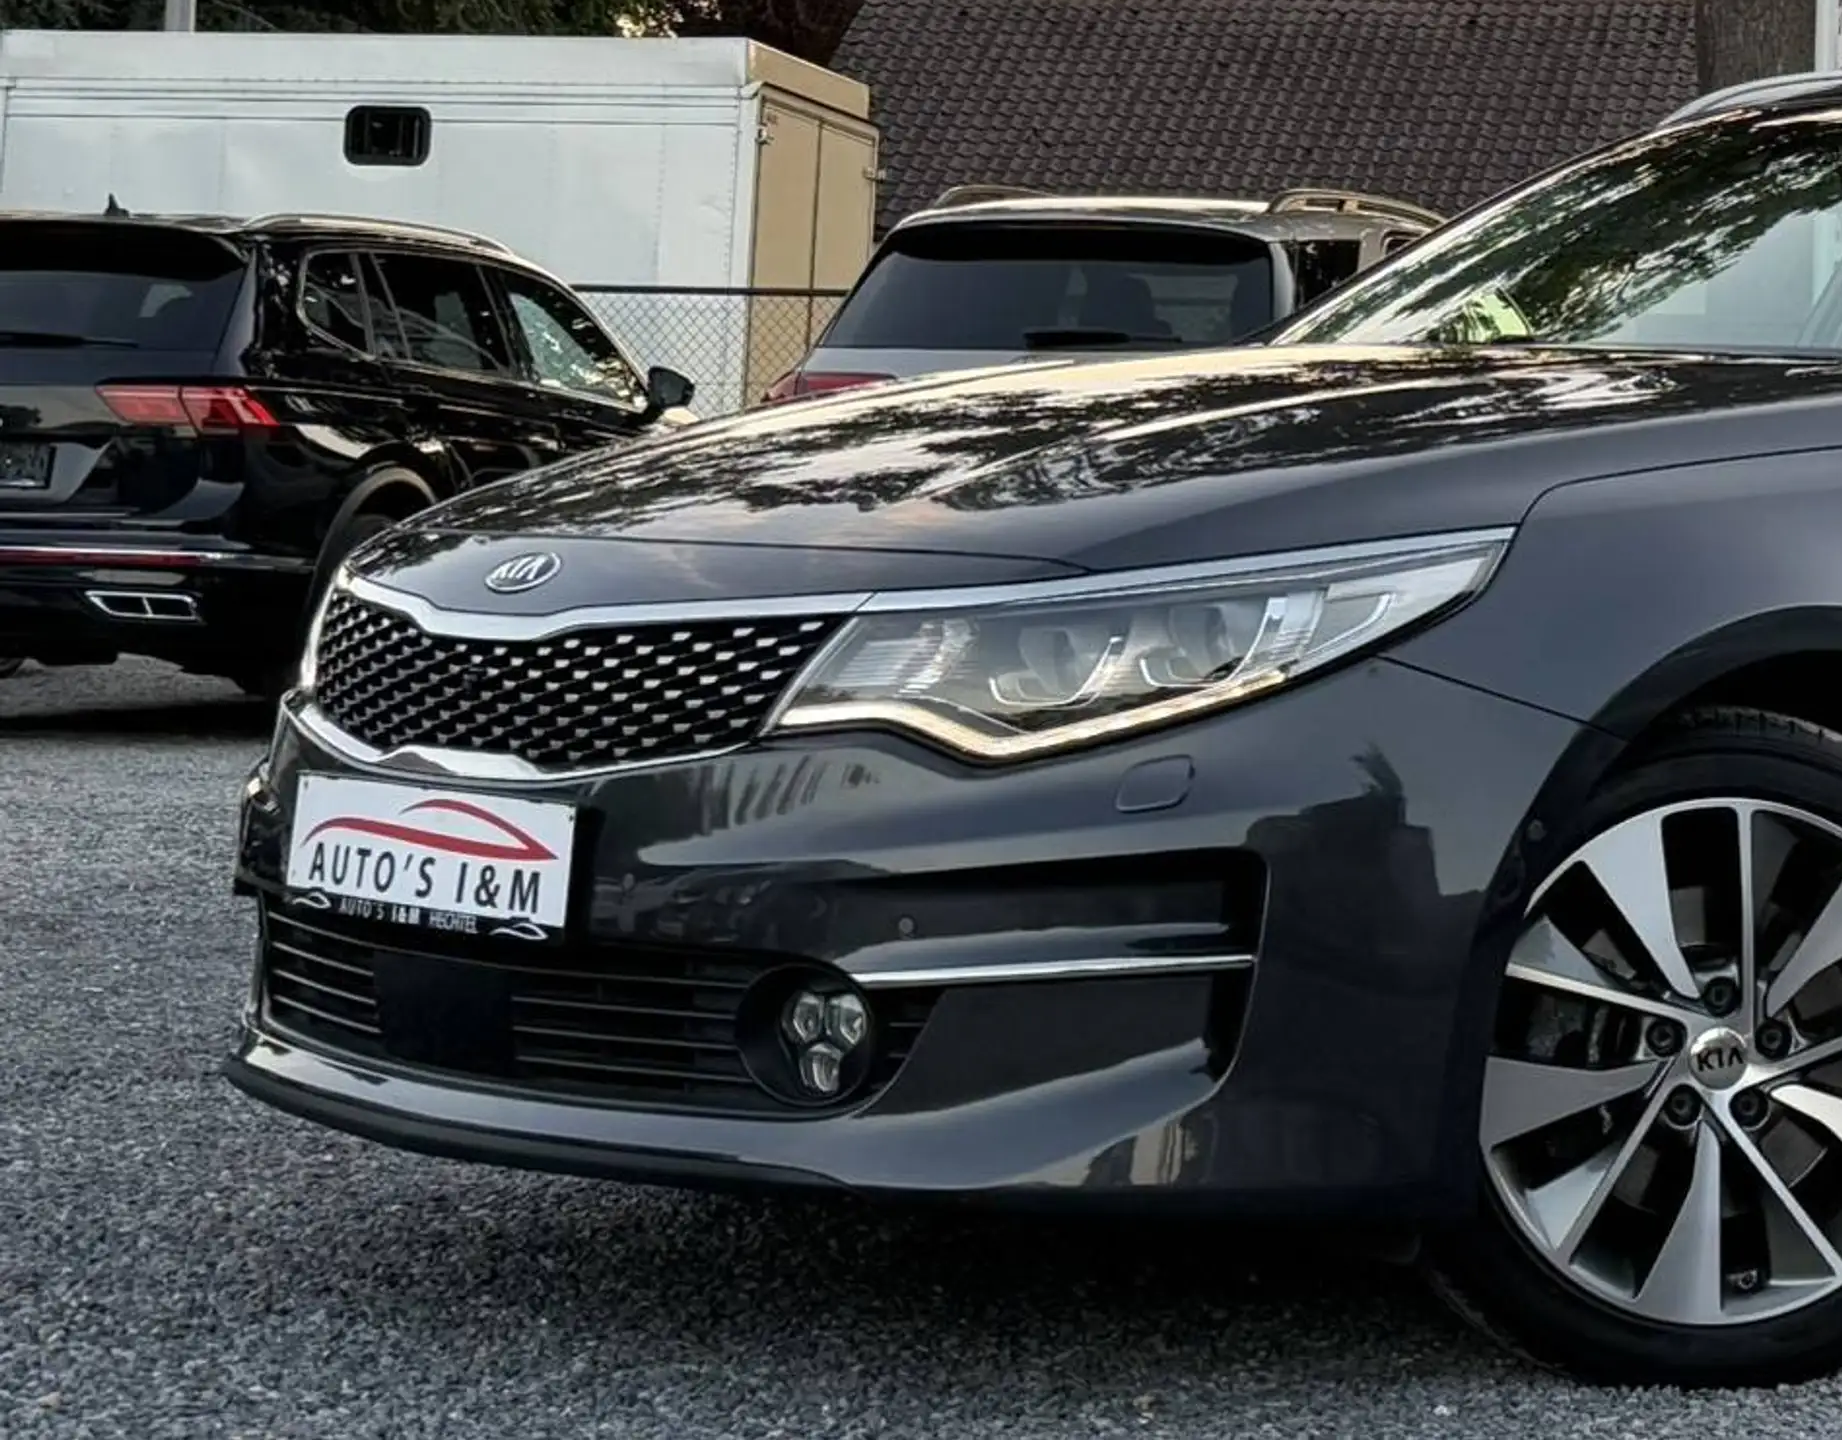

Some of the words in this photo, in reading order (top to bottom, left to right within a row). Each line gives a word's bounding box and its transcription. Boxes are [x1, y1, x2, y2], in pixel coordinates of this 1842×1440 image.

[308, 841, 436, 898] AUTO'S
[455, 862, 541, 914] I&M
[339, 897, 385, 919] AUTO'S
[391, 905, 421, 925] I&M
[1696, 1047, 1744, 1072] KIA
